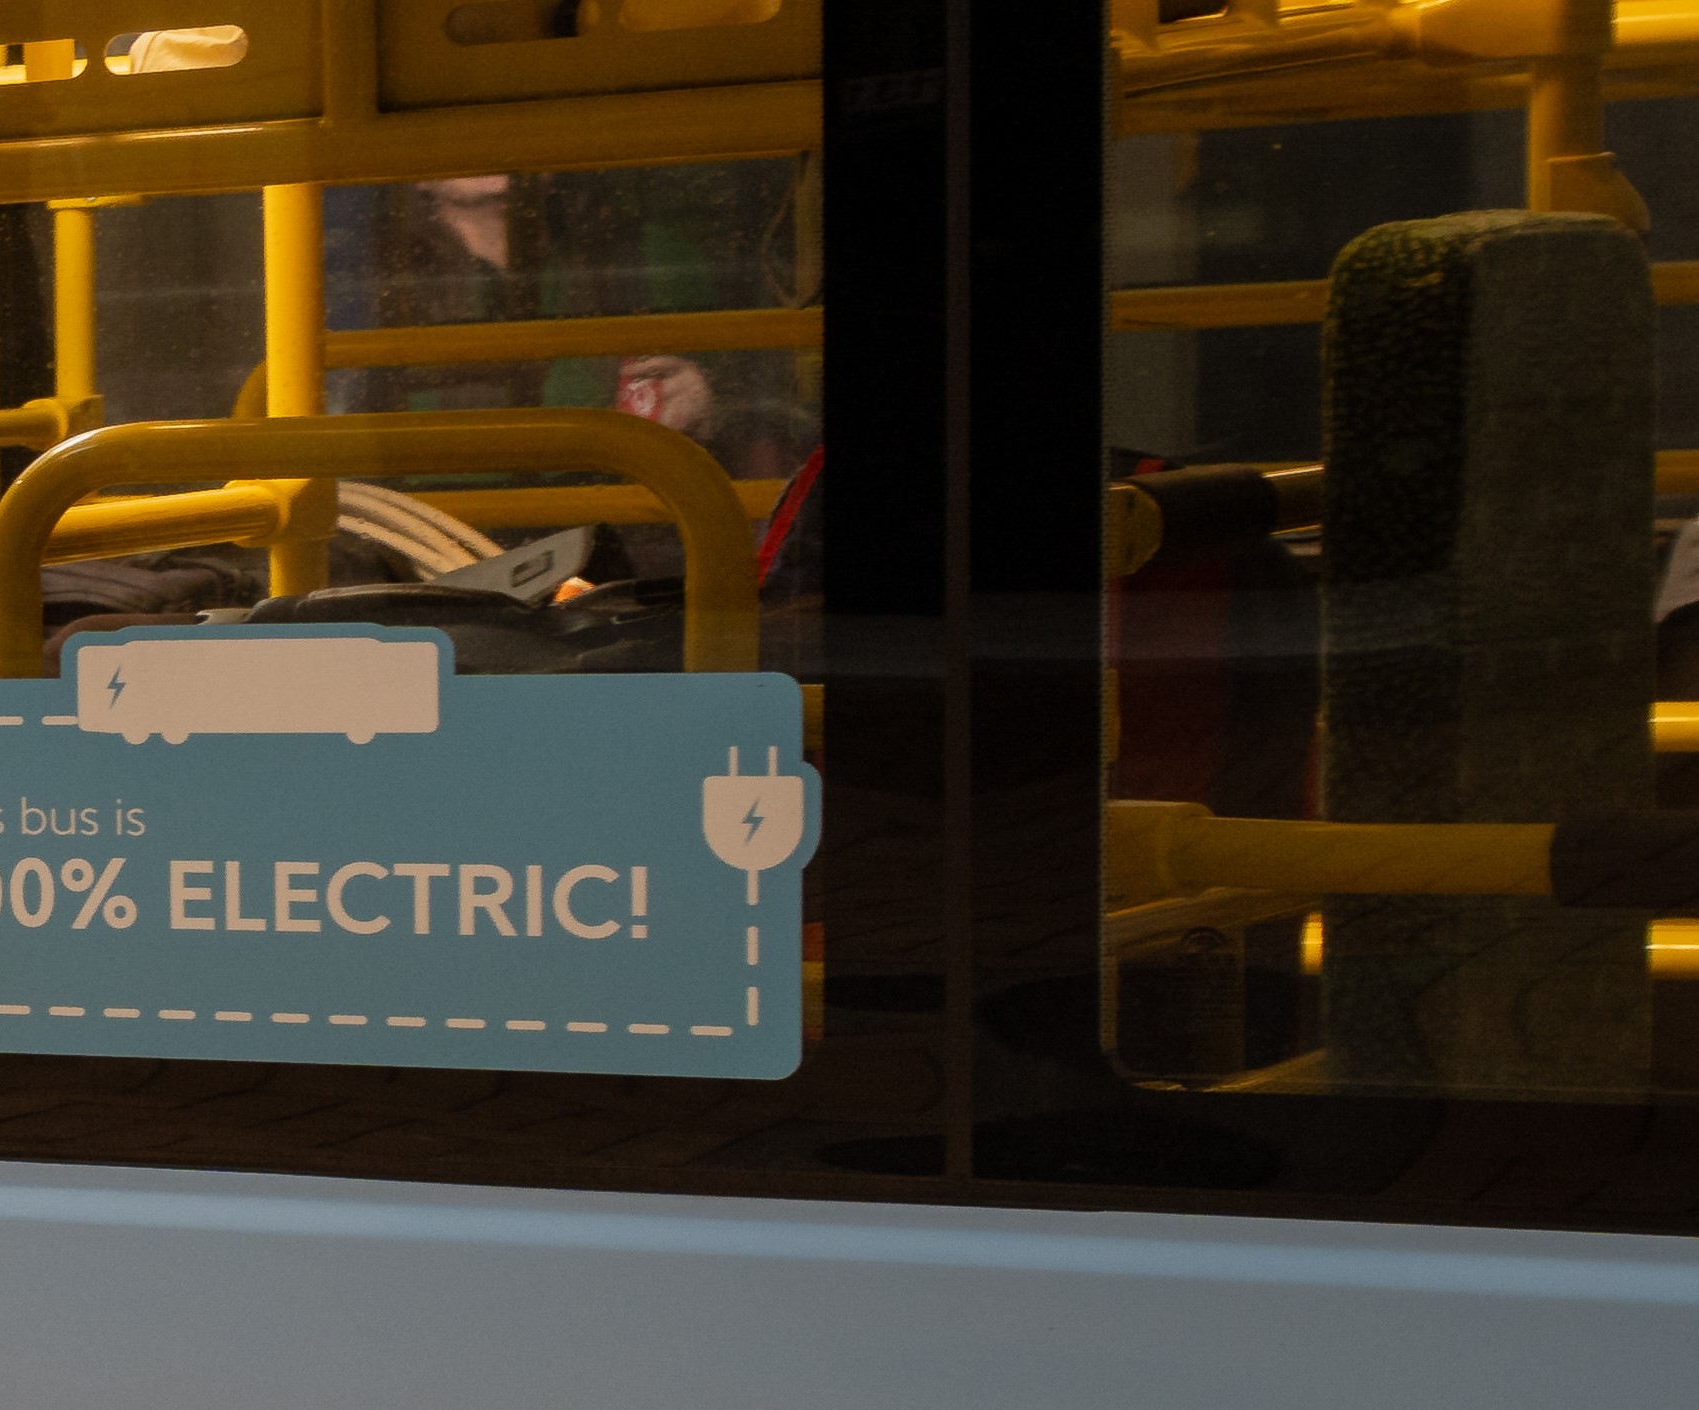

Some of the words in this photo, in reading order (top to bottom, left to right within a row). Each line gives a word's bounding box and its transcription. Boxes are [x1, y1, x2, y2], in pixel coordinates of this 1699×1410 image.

[20, 797, 99, 837] bus
[115, 799, 146, 837] is
[168, 860, 648, 940] ELECTRIC!
